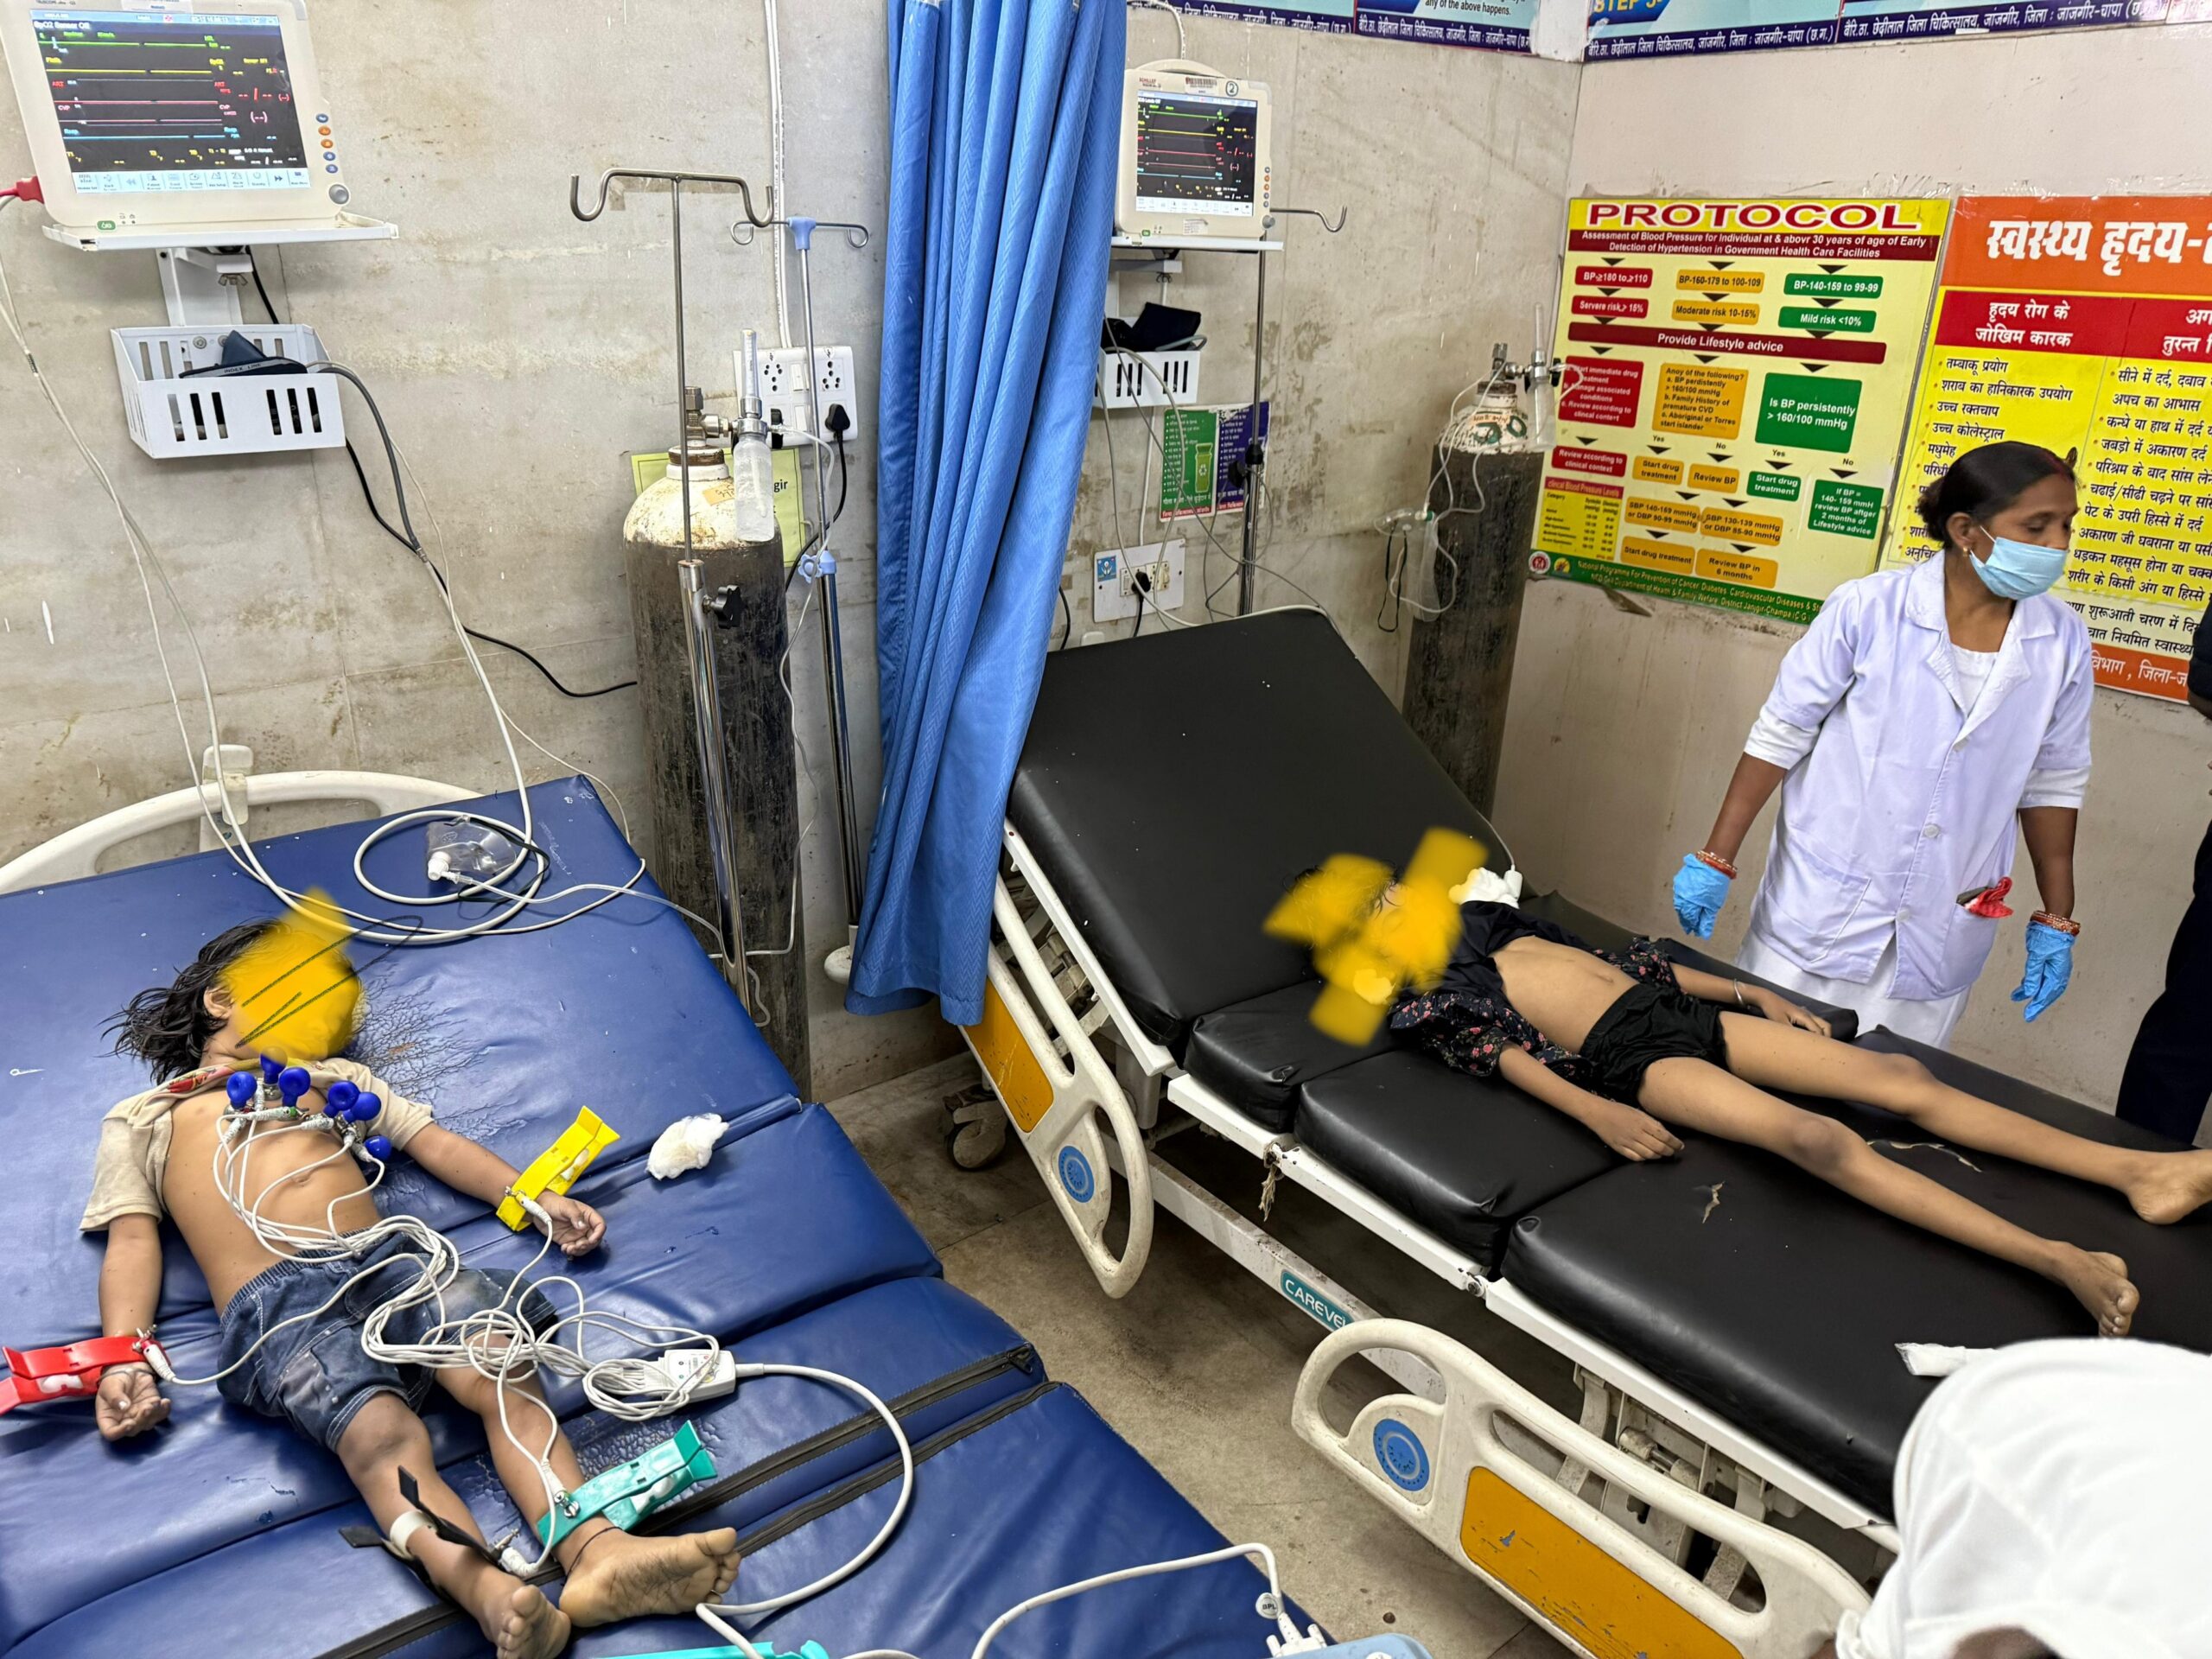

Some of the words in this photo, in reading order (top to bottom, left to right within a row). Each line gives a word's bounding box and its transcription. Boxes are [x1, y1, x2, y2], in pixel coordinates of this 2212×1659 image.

[1461, 3, 1480, 11] above
[1483, 4, 1511, 16] happens.
[1906, 15, 1928, 33] जिला
[2024, 4, 2048, 23] जिला
[1637, 37, 1654, 53] जिला
[1729, 30, 1747, 47] जिला
[1588, 203, 1919, 231] PROTOCOL
[1582, 231, 1630, 240] Assessment
[1631, 232, 1640, 240] of
[1641, 232, 1664, 241] Blood
[1666, 232, 1702, 242] Pressure
[1705, 233, 1717, 242] for
[1719, 234, 1762, 243] Individual
[1774, 235, 1782, 244] &
[1826, 237, 1852, 246] years
[1855, 236, 1865, 245] of
[1867, 238, 1885, 247] age
[1888, 237, 1899, 245] of
[1900, 237, 1926, 248] Early
[1609, 243, 1645, 251] Detection
[1658, 244, 1712, 254] Hypertension
[1725, 245, 1778, 256] Government
[1781, 247, 1810, 256] Health
[1813, 248, 1834, 257] Care
[1837, 247, 1880, 257] Facilities
[2100, 221, 2212, 276] हृदय-
[1722, 276, 1729, 285] to
[1732, 277, 1761, 286] 100-109
[1844, 283, 1852, 291] to
[1855, 283, 1878, 292] 99-99
[1676, 306, 1710, 315] Moderate
[1712, 308, 1726, 316] risk
[1729, 309, 1757, 319] 10-15%
[1988, 302, 2020, 322] हृदय
[2024, 298, 2049, 319] रोग
[2053, 300, 2070, 321] के
[1800, 314, 1818, 323] Mild
[1820, 315, 1835, 325] risk
[1838, 315, 1861, 326] <10%
[1658, 334, 1696, 345] Provide
[1699, 334, 1744, 350] Lifestyle
[1747, 341, 1783, 352] advice
[1976, 322, 2025, 345] जोखिम
[2030, 330, 2074, 347] कारक
[1947, 358, 1979, 375] तम्बाकू
[1983, 357, 2008, 372] प्रयोग
[1707, 371, 1745, 381] following?
[2118, 366, 2139, 382] सीने
[2143, 367, 2152, 383] में
[2177, 375, 2206, 387] दबाव
[1942, 379, 1966, 391] शराब
[1970, 382, 1984, 393] का
[1987, 379, 2036, 397] हानिकारक
[2039, 385, 2073, 401] उपयोग
[1672, 394, 1694, 404] Family
[1695, 397, 1721, 407] History
[1770, 398, 1778, 408] Is
[1781, 400, 1795, 409] BP
[1796, 401, 1856, 416] persistently
[1937, 401, 1958, 412] उच्च
[1962, 403, 1999, 416] रक्तचाप
[2113, 394, 2140, 406] अपच
[2145, 396, 2159, 408] का
[2164, 397, 2201, 411] आभास
[1669, 412, 1703, 423] Aboriginal
[1777, 413, 1813, 425] 160/100
[1815, 416, 1847, 430] mmHg
[1932, 422, 1954, 434] उच्च
[2135, 419, 2147, 430] या
[2151, 421, 2171, 433] हाथ
[2175, 418, 2184, 434] में
[2188, 420, 2203, 437] दर्द
[1929, 442, 1956, 458] मधुमेह
[2134, 438, 2144, 453] में
[2147, 444, 2188, 458] अकारण
[2191, 444, 2208, 461] दर्द
[1643, 460, 1662, 469] Start
[1664, 462, 1680, 472] drug
[2095, 458, 2128, 474] परिश्रम
[2132, 461, 2144, 477] के
[2147, 467, 2167, 480] बाद
[2171, 467, 2194, 482] सांस
[1694, 473, 1723, 483] Review
[1725, 476, 1736, 485] BP
[1778, 478, 1797, 487] drug
[1754, 484, 1796, 496] treatment
[1815, 503, 1840, 512] review
[1841, 505, 1853, 514] BP
[2179, 494, 2192, 506] पर
[1828, 513, 1856, 524] months
[2085, 502, 2100, 518] पेट
[2103, 505, 2114, 519] के
[2118, 508, 2141, 523] उपरी
[2175, 513, 2184, 529] में
[2188, 516, 2204, 532] दर्द
[1813, 519, 1845, 531] Lifestyle
[1847, 524, 1872, 535] advice
[2079, 528, 2117, 542] अकारण
[2121, 531, 2135, 545] जी
[2139, 536, 2174, 550] घबराना
[2178, 541, 2191, 553] या
[1709, 557, 1736, 567] Review
[2110, 554, 2142, 573] महसूस
[2145, 556, 2167, 573] होना
[2171, 563, 2184, 575] या
[1723, 570, 1752, 580] months
[2068, 569, 2090, 582] शरीर
[2094, 571, 2105, 586] के
[2108, 573, 2135, 590] किसी
[2139, 579, 2158, 594] अंग
[2162, 585, 2175, 597] या
[2139, 613, 2164, 627] चरण
[2169, 615, 2179, 630] में
[2111, 627, 2151, 647] नियमित
